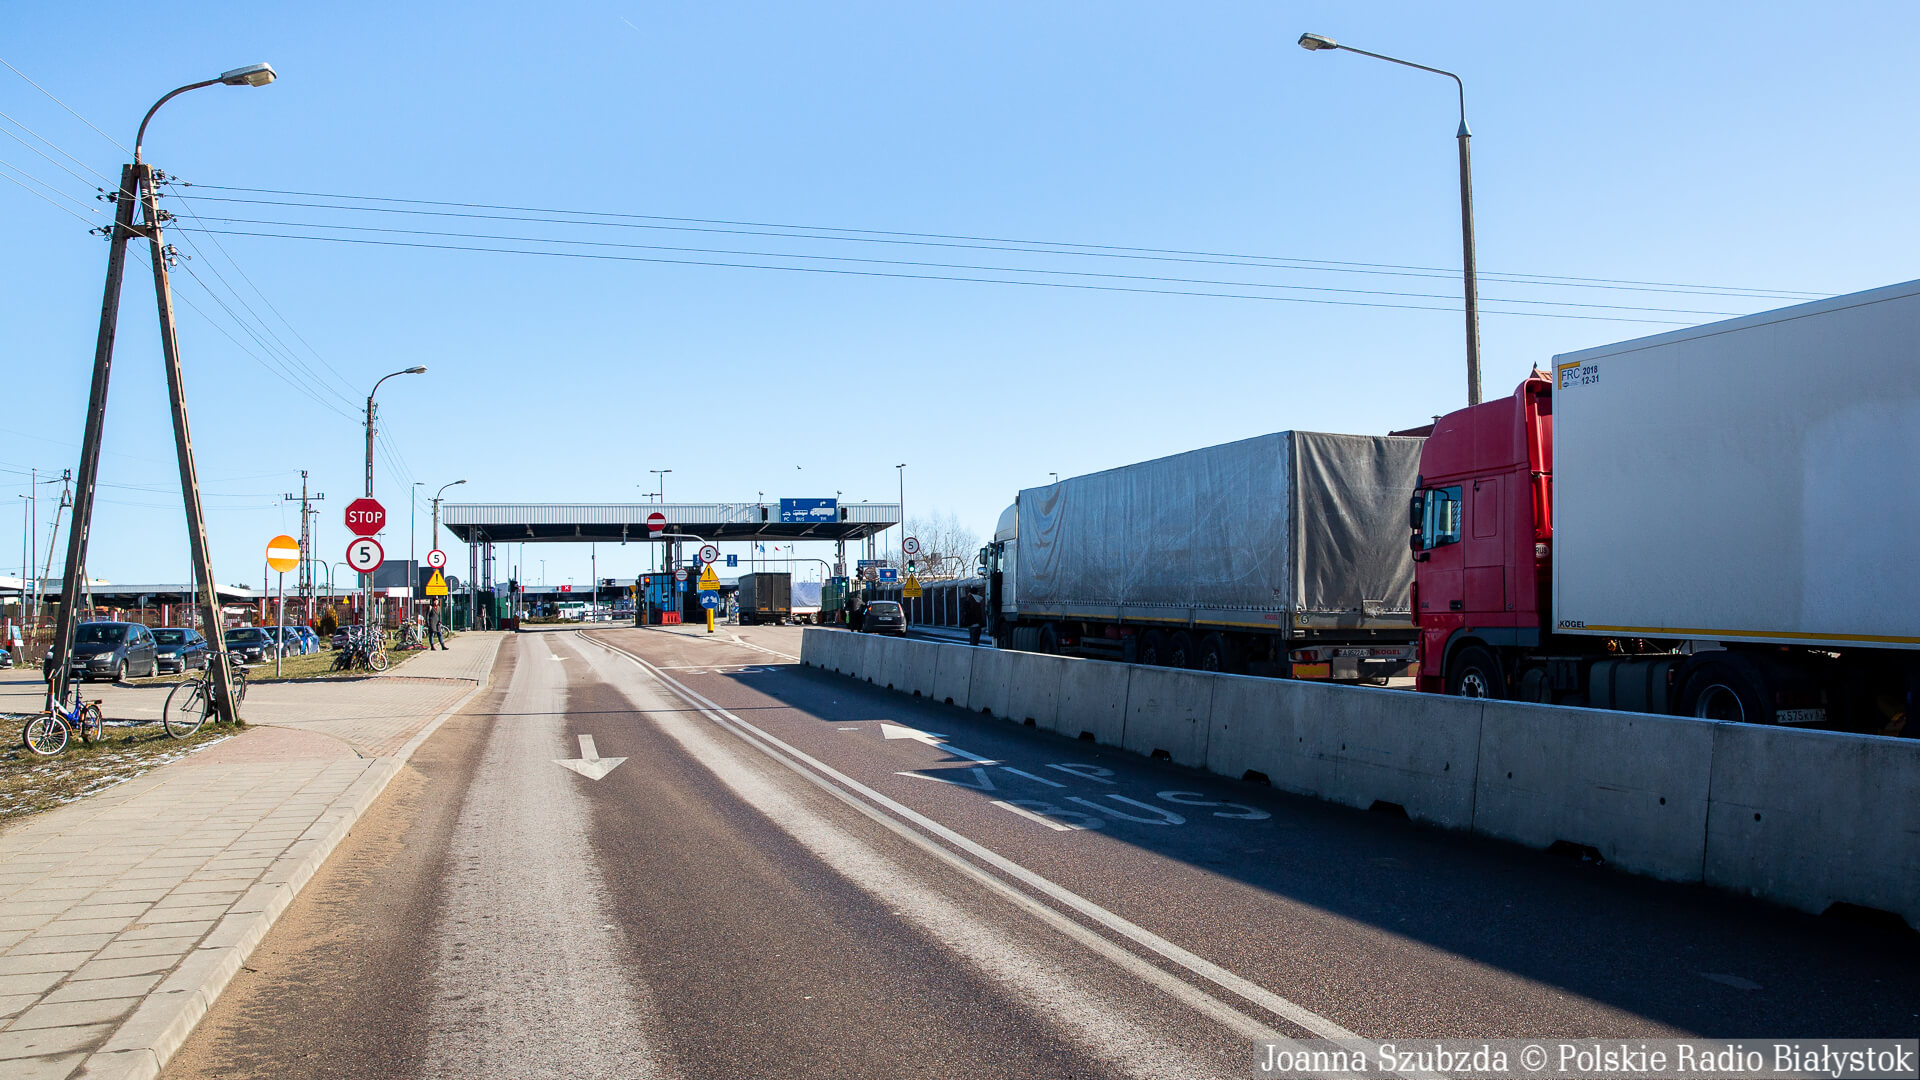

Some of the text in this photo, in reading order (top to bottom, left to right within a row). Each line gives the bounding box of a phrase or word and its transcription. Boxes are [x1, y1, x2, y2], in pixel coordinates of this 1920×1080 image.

[1561, 365, 1598, 381] FRC 2018
[1581, 374, 1600, 385] 12-31
[349, 510, 383, 524] STOP
[908, 541, 914, 550] 5
[1536, 546, 1548, 554] RUS
[360, 546, 371, 563] 5
[433, 554, 440, 564] 5
[705, 549, 712, 559] 5
[1302, 615, 1308, 624] 5
[895, 763, 1116, 790] VIP
[989, 791, 1271, 832] BUS
